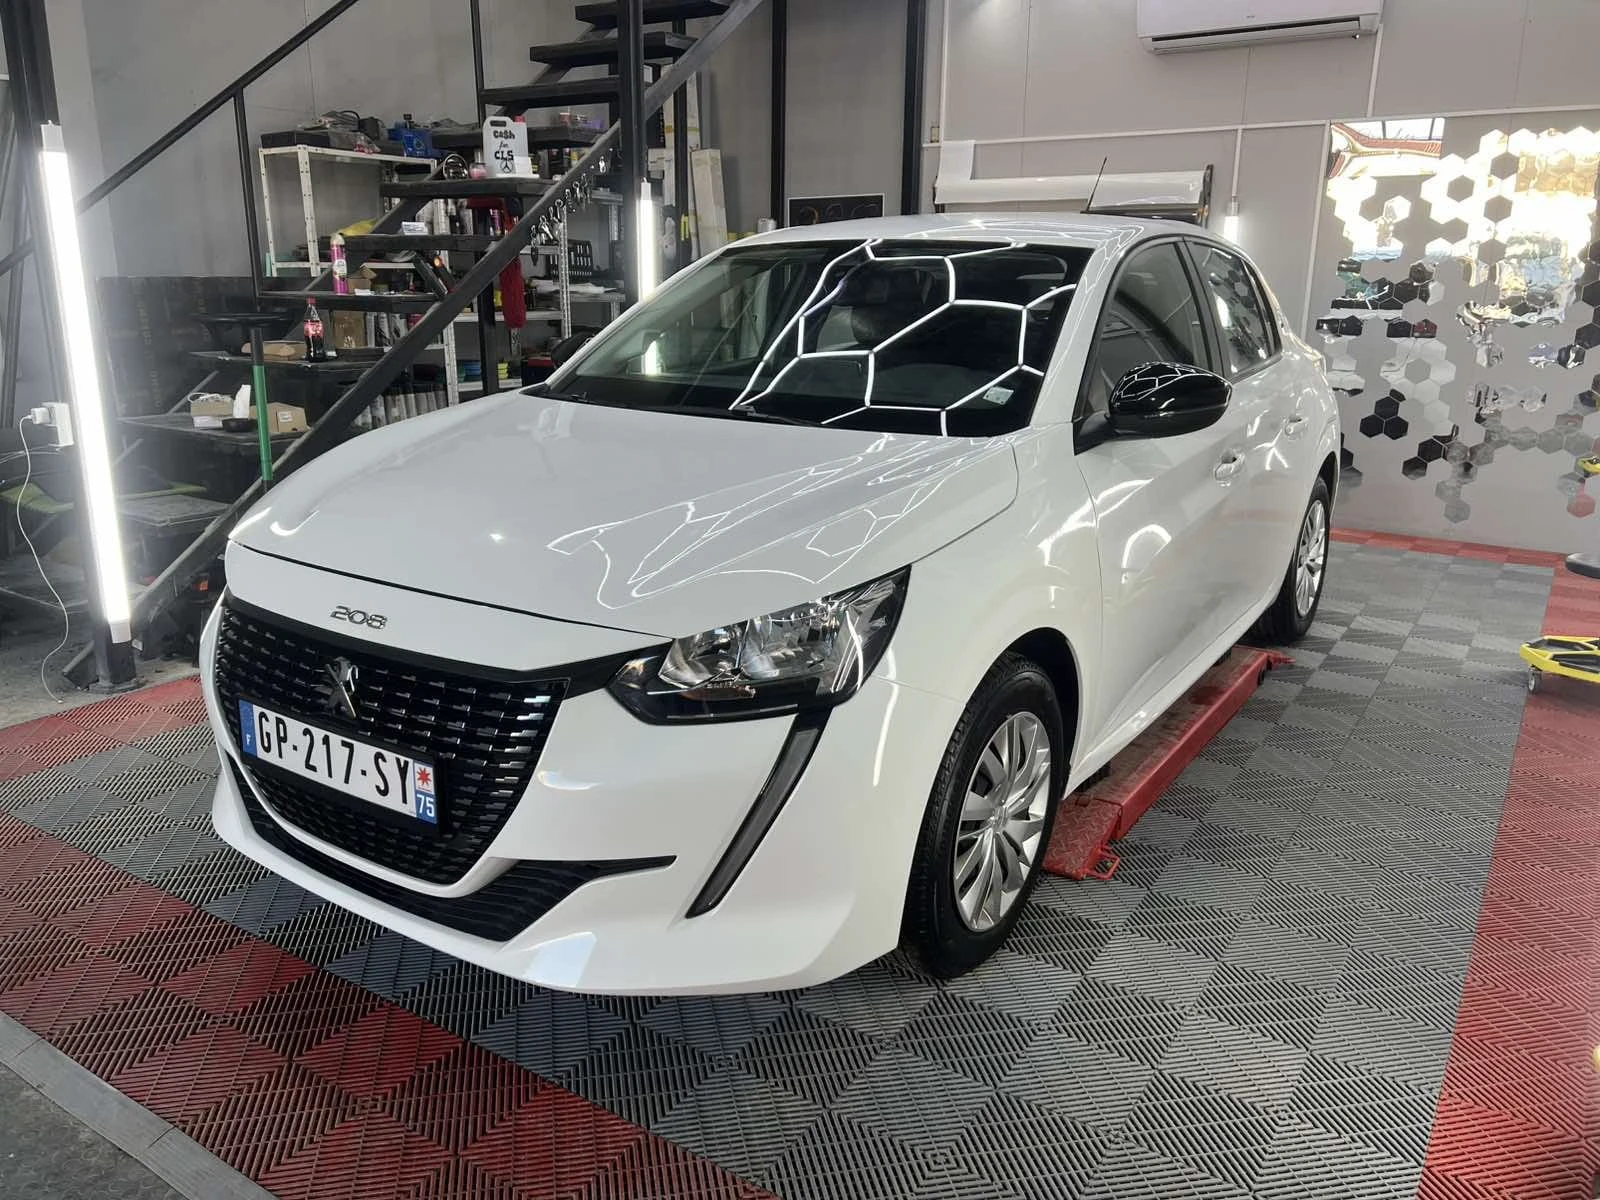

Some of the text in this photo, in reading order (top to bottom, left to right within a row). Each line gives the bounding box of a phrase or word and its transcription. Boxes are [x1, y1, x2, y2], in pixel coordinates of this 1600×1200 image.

[494, 150, 514, 161] CLS
[330, 605, 388, 629] 208
[246, 733, 251, 745] F
[258, 711, 409, 805] GP-217-SY
[416, 793, 435, 817] 75
